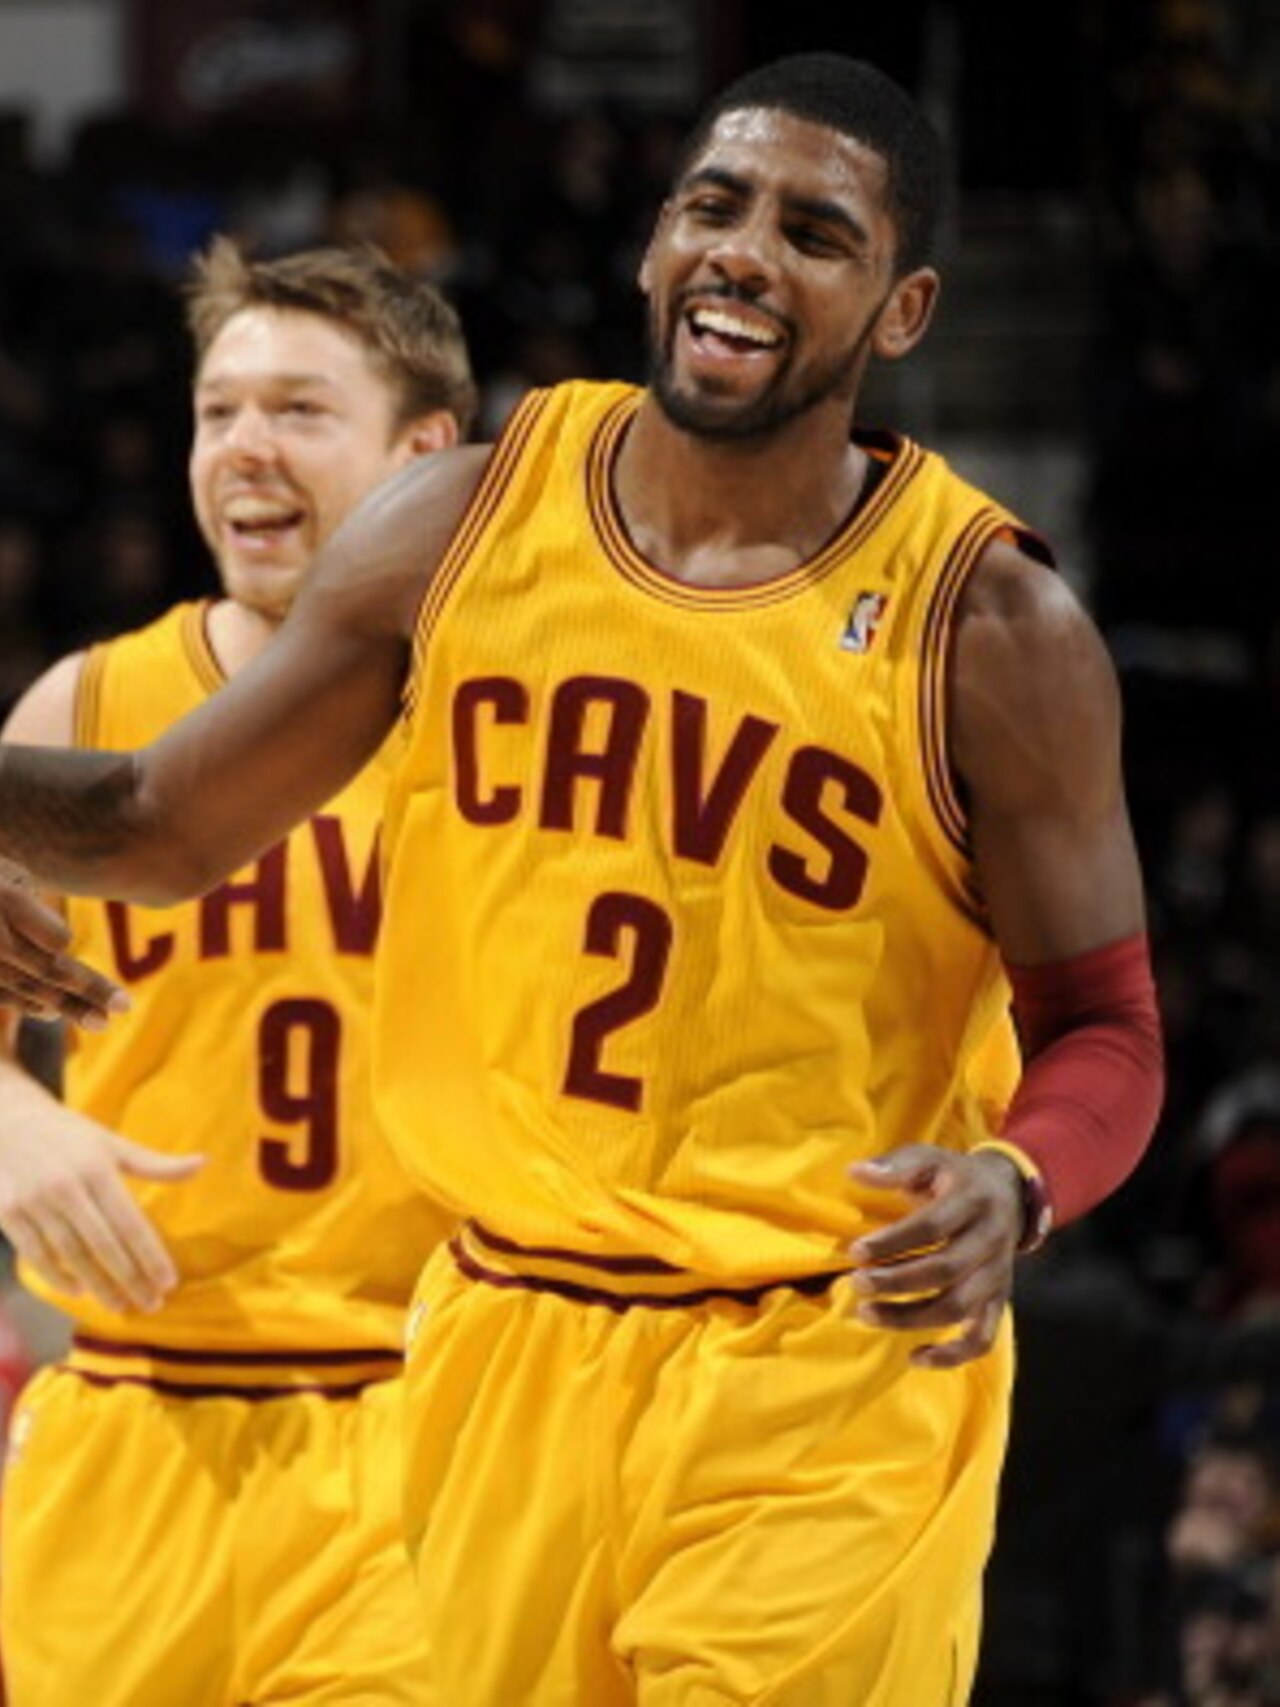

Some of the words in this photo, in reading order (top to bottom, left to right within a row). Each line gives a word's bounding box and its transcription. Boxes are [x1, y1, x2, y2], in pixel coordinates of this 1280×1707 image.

[452, 675, 883, 912] CAVS
[103, 815, 383, 985] CAV
[563, 891, 673, 1113] 2
[258, 997, 341, 1192] 9
